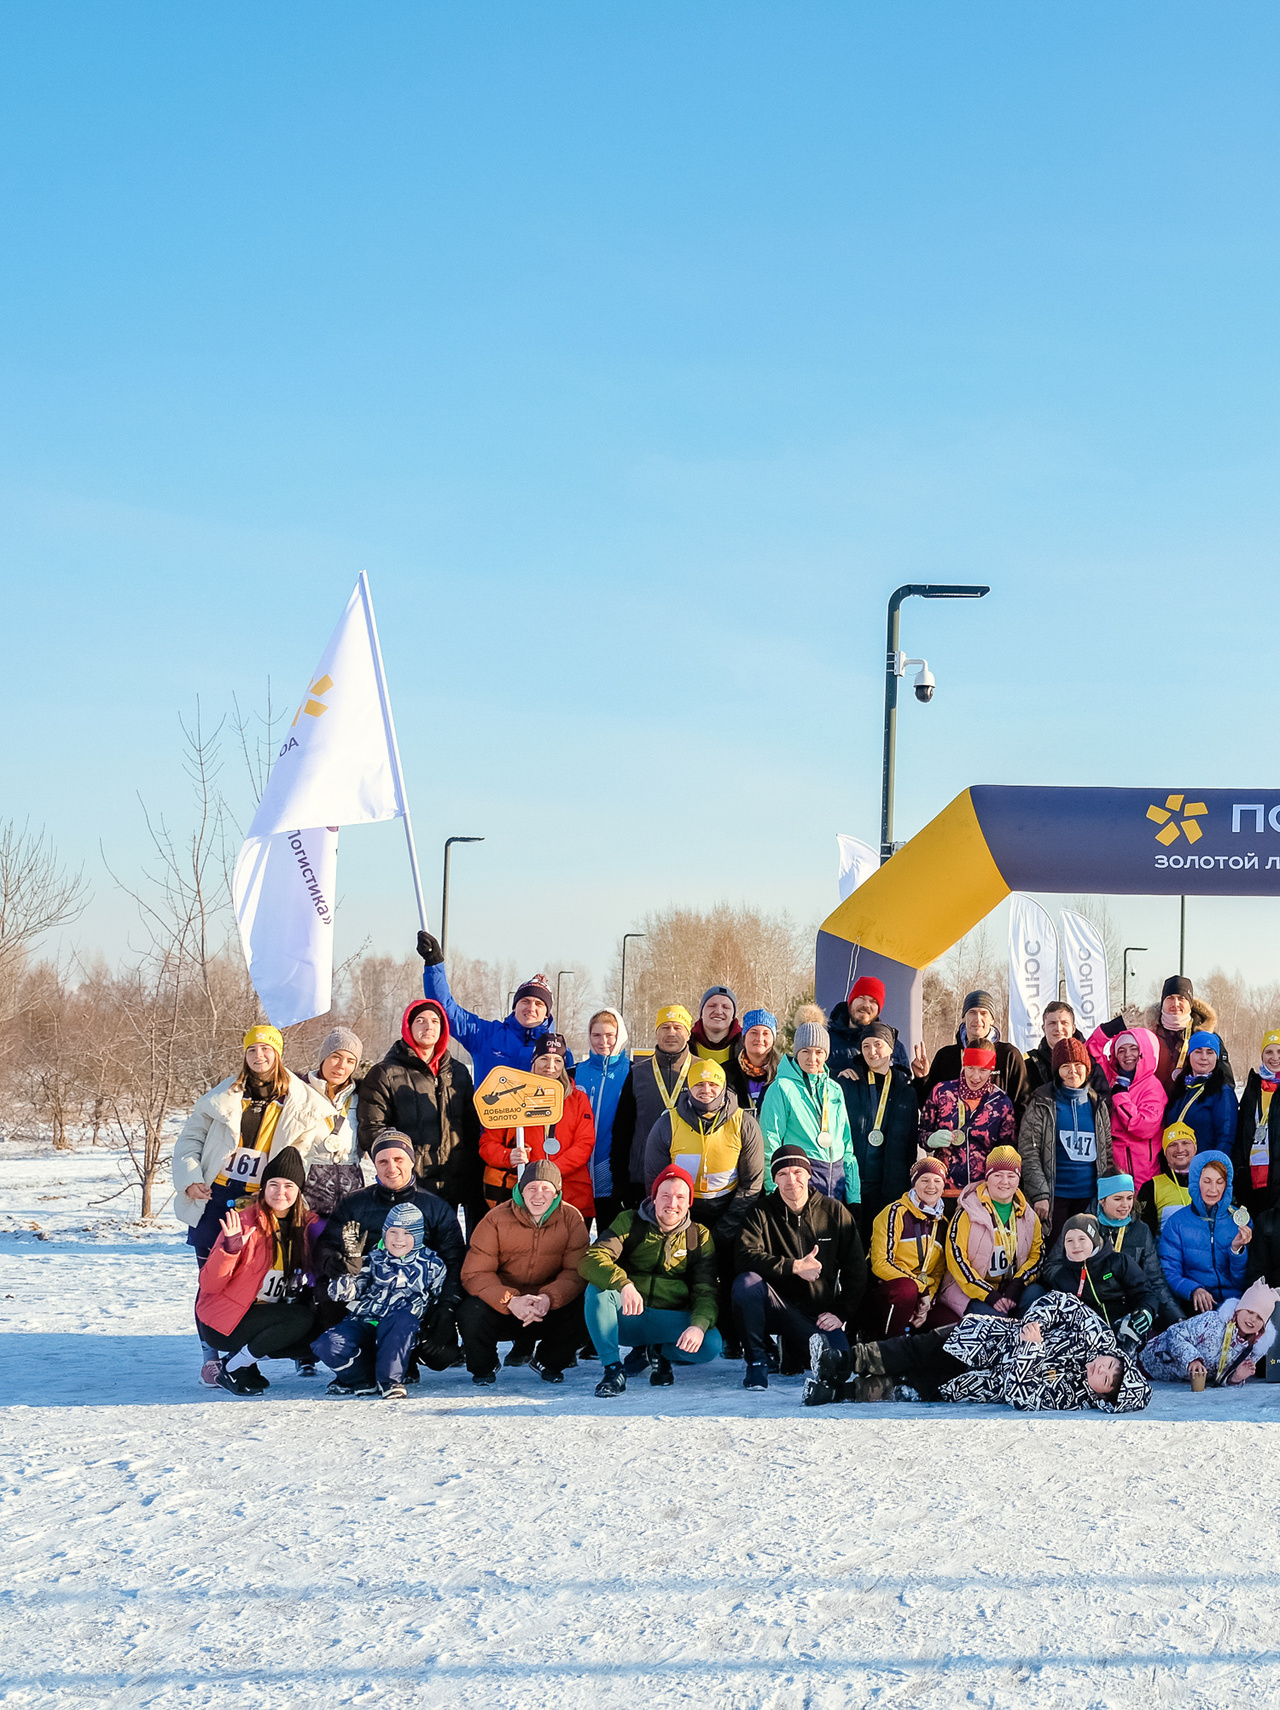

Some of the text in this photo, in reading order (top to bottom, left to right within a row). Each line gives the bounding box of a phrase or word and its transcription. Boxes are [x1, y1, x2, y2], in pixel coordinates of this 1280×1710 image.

[1154, 852, 1259, 870] ЗОЛОТОЙ
[483, 1107, 522, 1116] ДОБЫВАЮ
[488, 1114, 518, 1122] ЗОЛОТО
[1065, 1136, 1092, 1156] 147
[225, 1152, 261, 1177] 161
